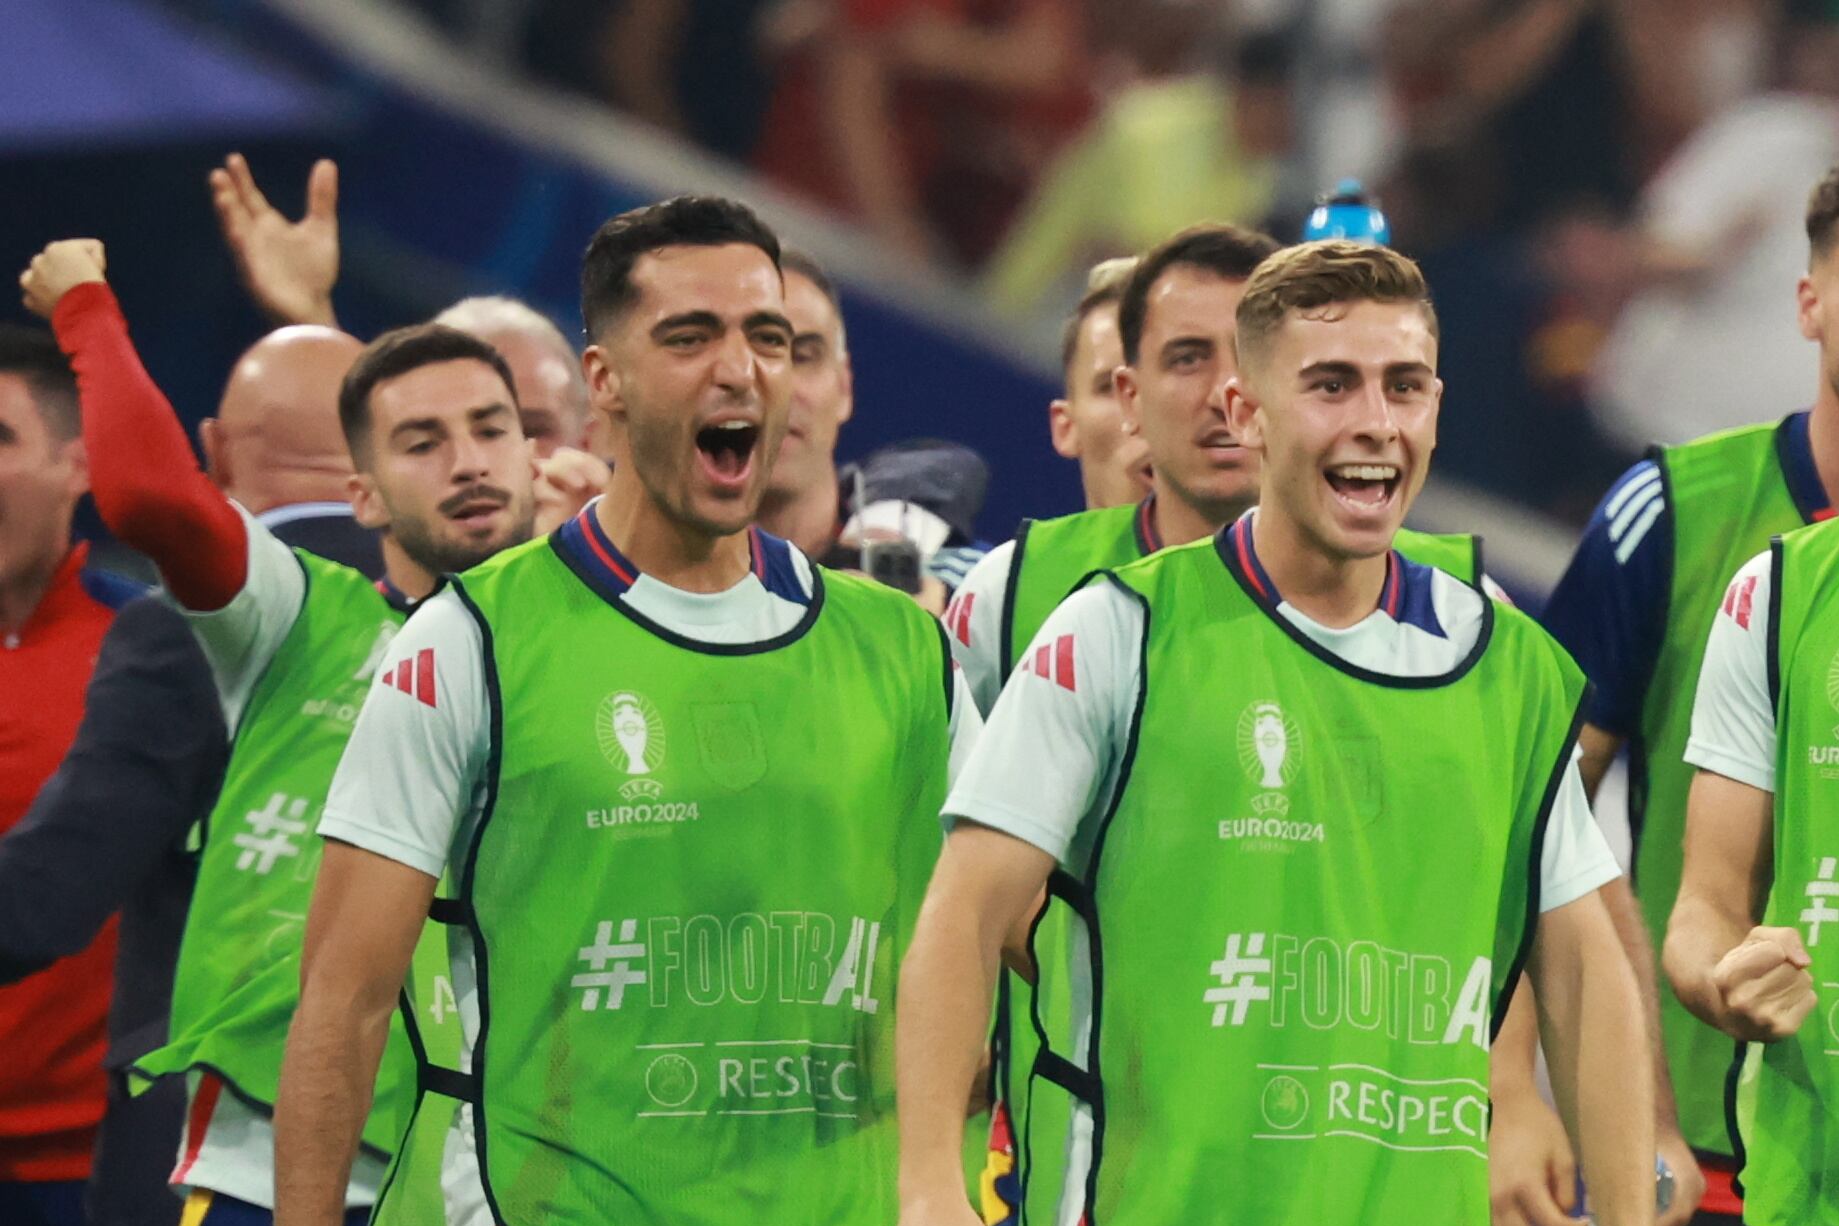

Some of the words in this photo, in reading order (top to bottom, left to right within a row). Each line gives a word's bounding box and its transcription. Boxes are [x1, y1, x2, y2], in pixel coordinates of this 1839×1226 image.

[586, 802, 699, 828] EURO2024
[1218, 817, 1325, 843] EURO2024
[1203, 932, 1491, 1052] #FOOTBA
